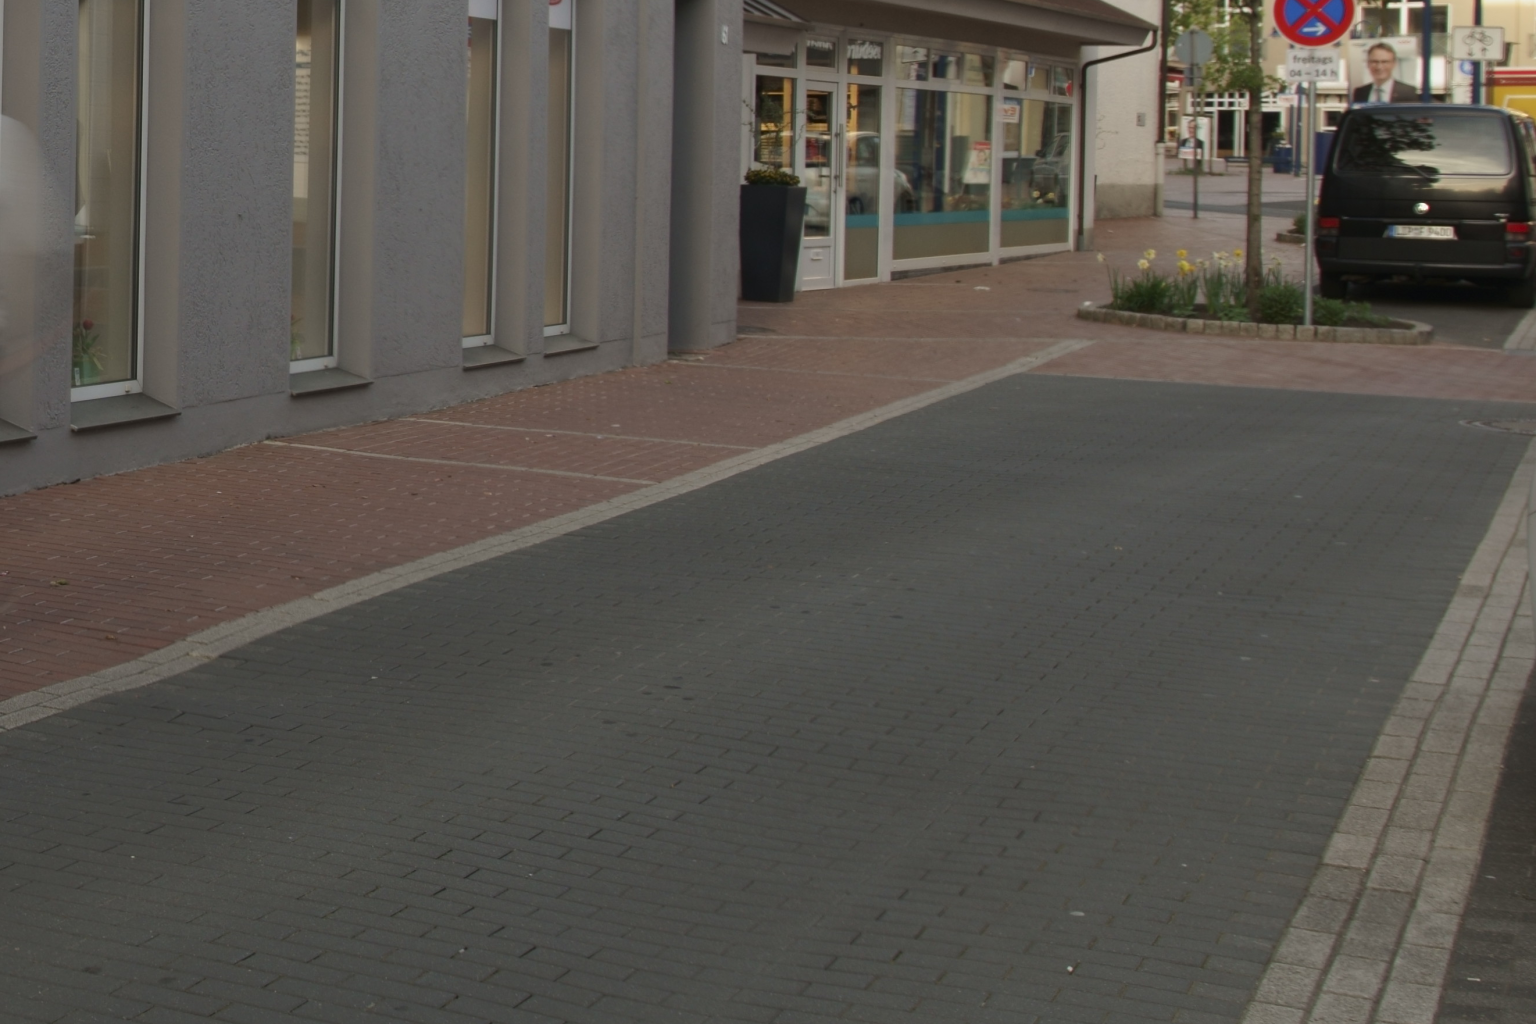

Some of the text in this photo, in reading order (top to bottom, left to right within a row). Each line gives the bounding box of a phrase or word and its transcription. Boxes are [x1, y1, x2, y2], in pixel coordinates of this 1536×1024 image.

[1292, 55, 1333, 65] freitags
[1289, 69, 1302, 77] 04
[1314, 69, 1327, 77] 14
